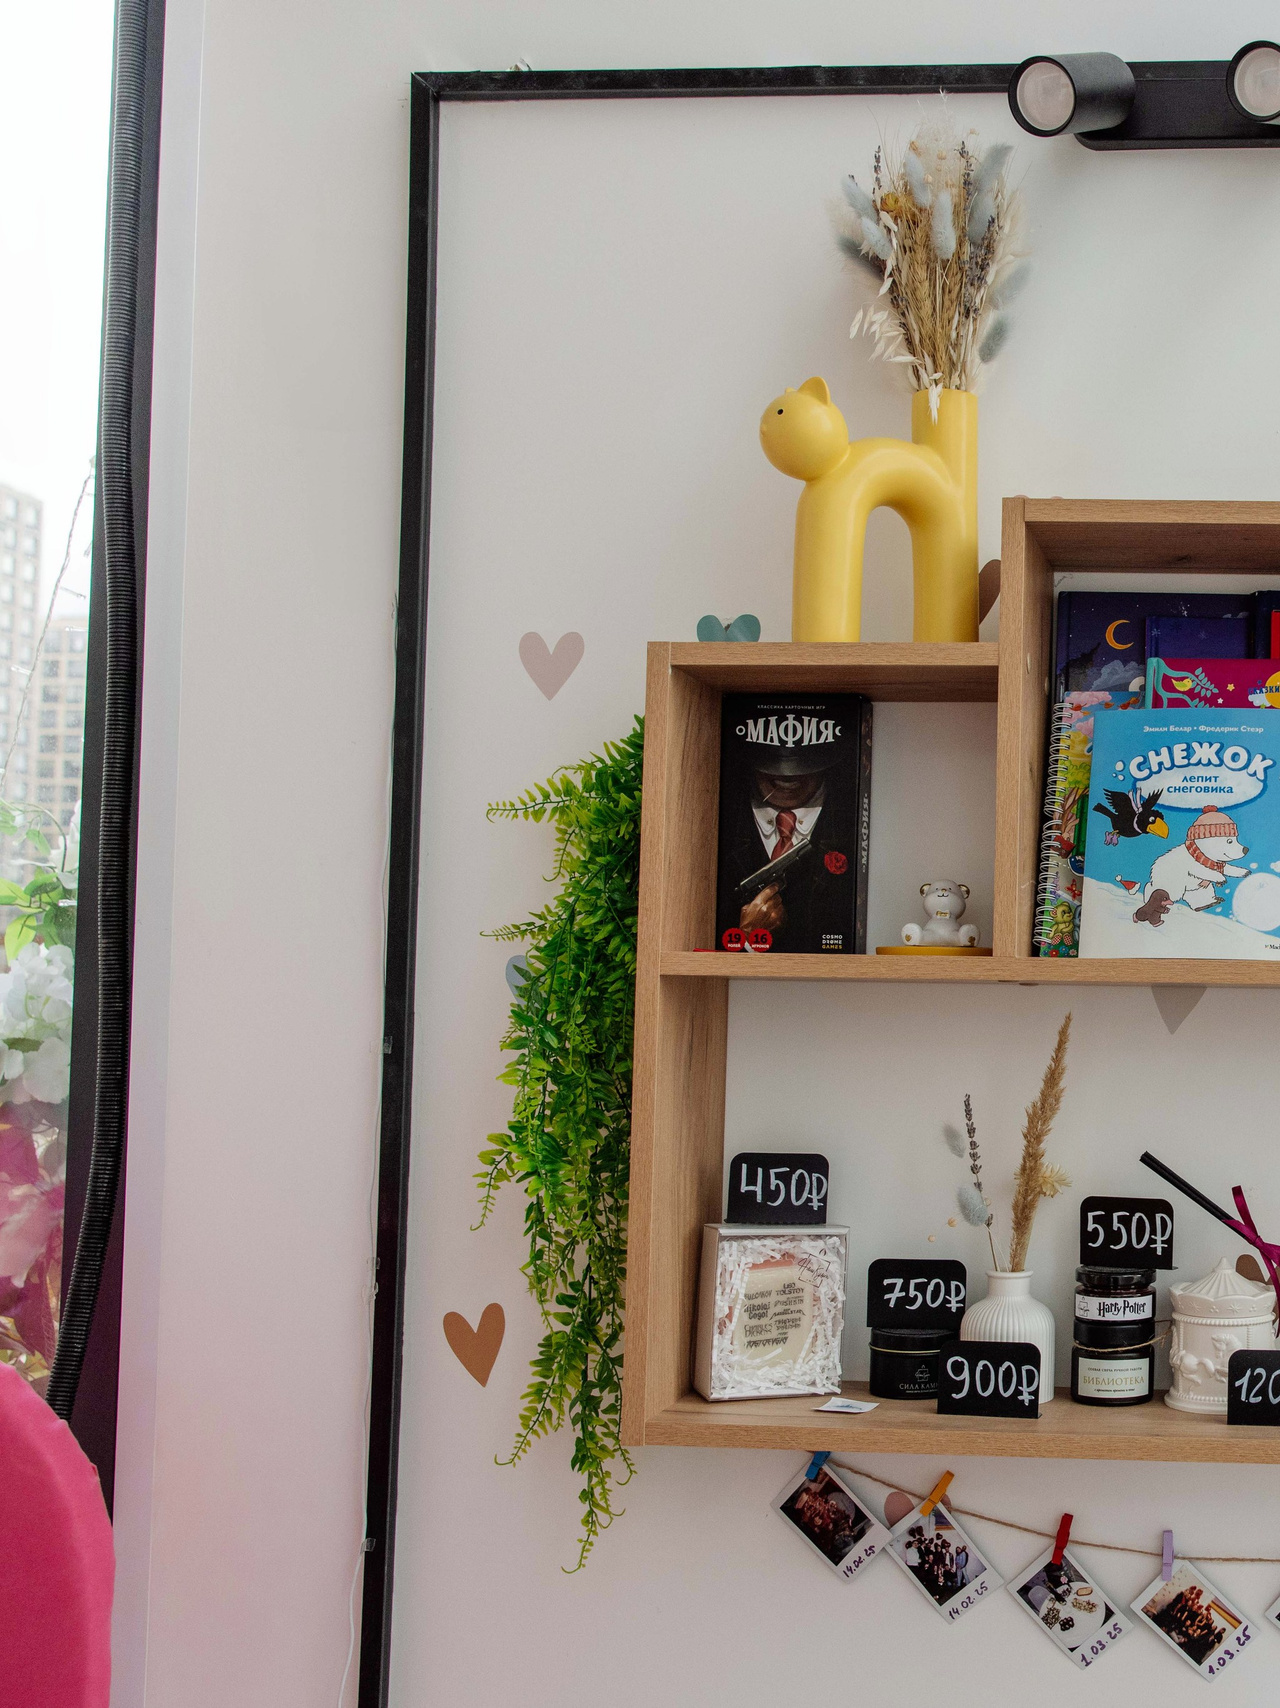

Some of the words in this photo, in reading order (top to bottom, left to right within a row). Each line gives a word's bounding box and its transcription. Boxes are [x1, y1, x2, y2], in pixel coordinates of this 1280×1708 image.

[1248, 685, 1280, 695] СКАЗКИ
[745, 714, 835, 748] МАФИЯ
[1143, 725, 1168, 733] Эмили
[1198, 724, 1239, 733] Фредерик
[1129, 741, 1275, 781] СНЕЖОК
[1182, 775, 1220, 783] лепит
[1166, 785, 1234, 794] снеговика
[727, 933, 741, 944] 19
[753, 933, 767, 944] 16
[740, 1163, 828, 1211] 450₽
[1087, 1210, 1172, 1256] 550₽
[775, 1287, 804, 1296] TOLSTOY
[883, 1278, 966, 1313] 750₽
[1097, 1301, 1122, 1318] Harry
[1122, 1299, 1147, 1318] Potter
[946, 1355, 1039, 1406] 900₽
[1083, 1375, 1145, 1386] БИБЛИОТЕКА
[1080, 1622, 1123, 1667] 1.03.25
